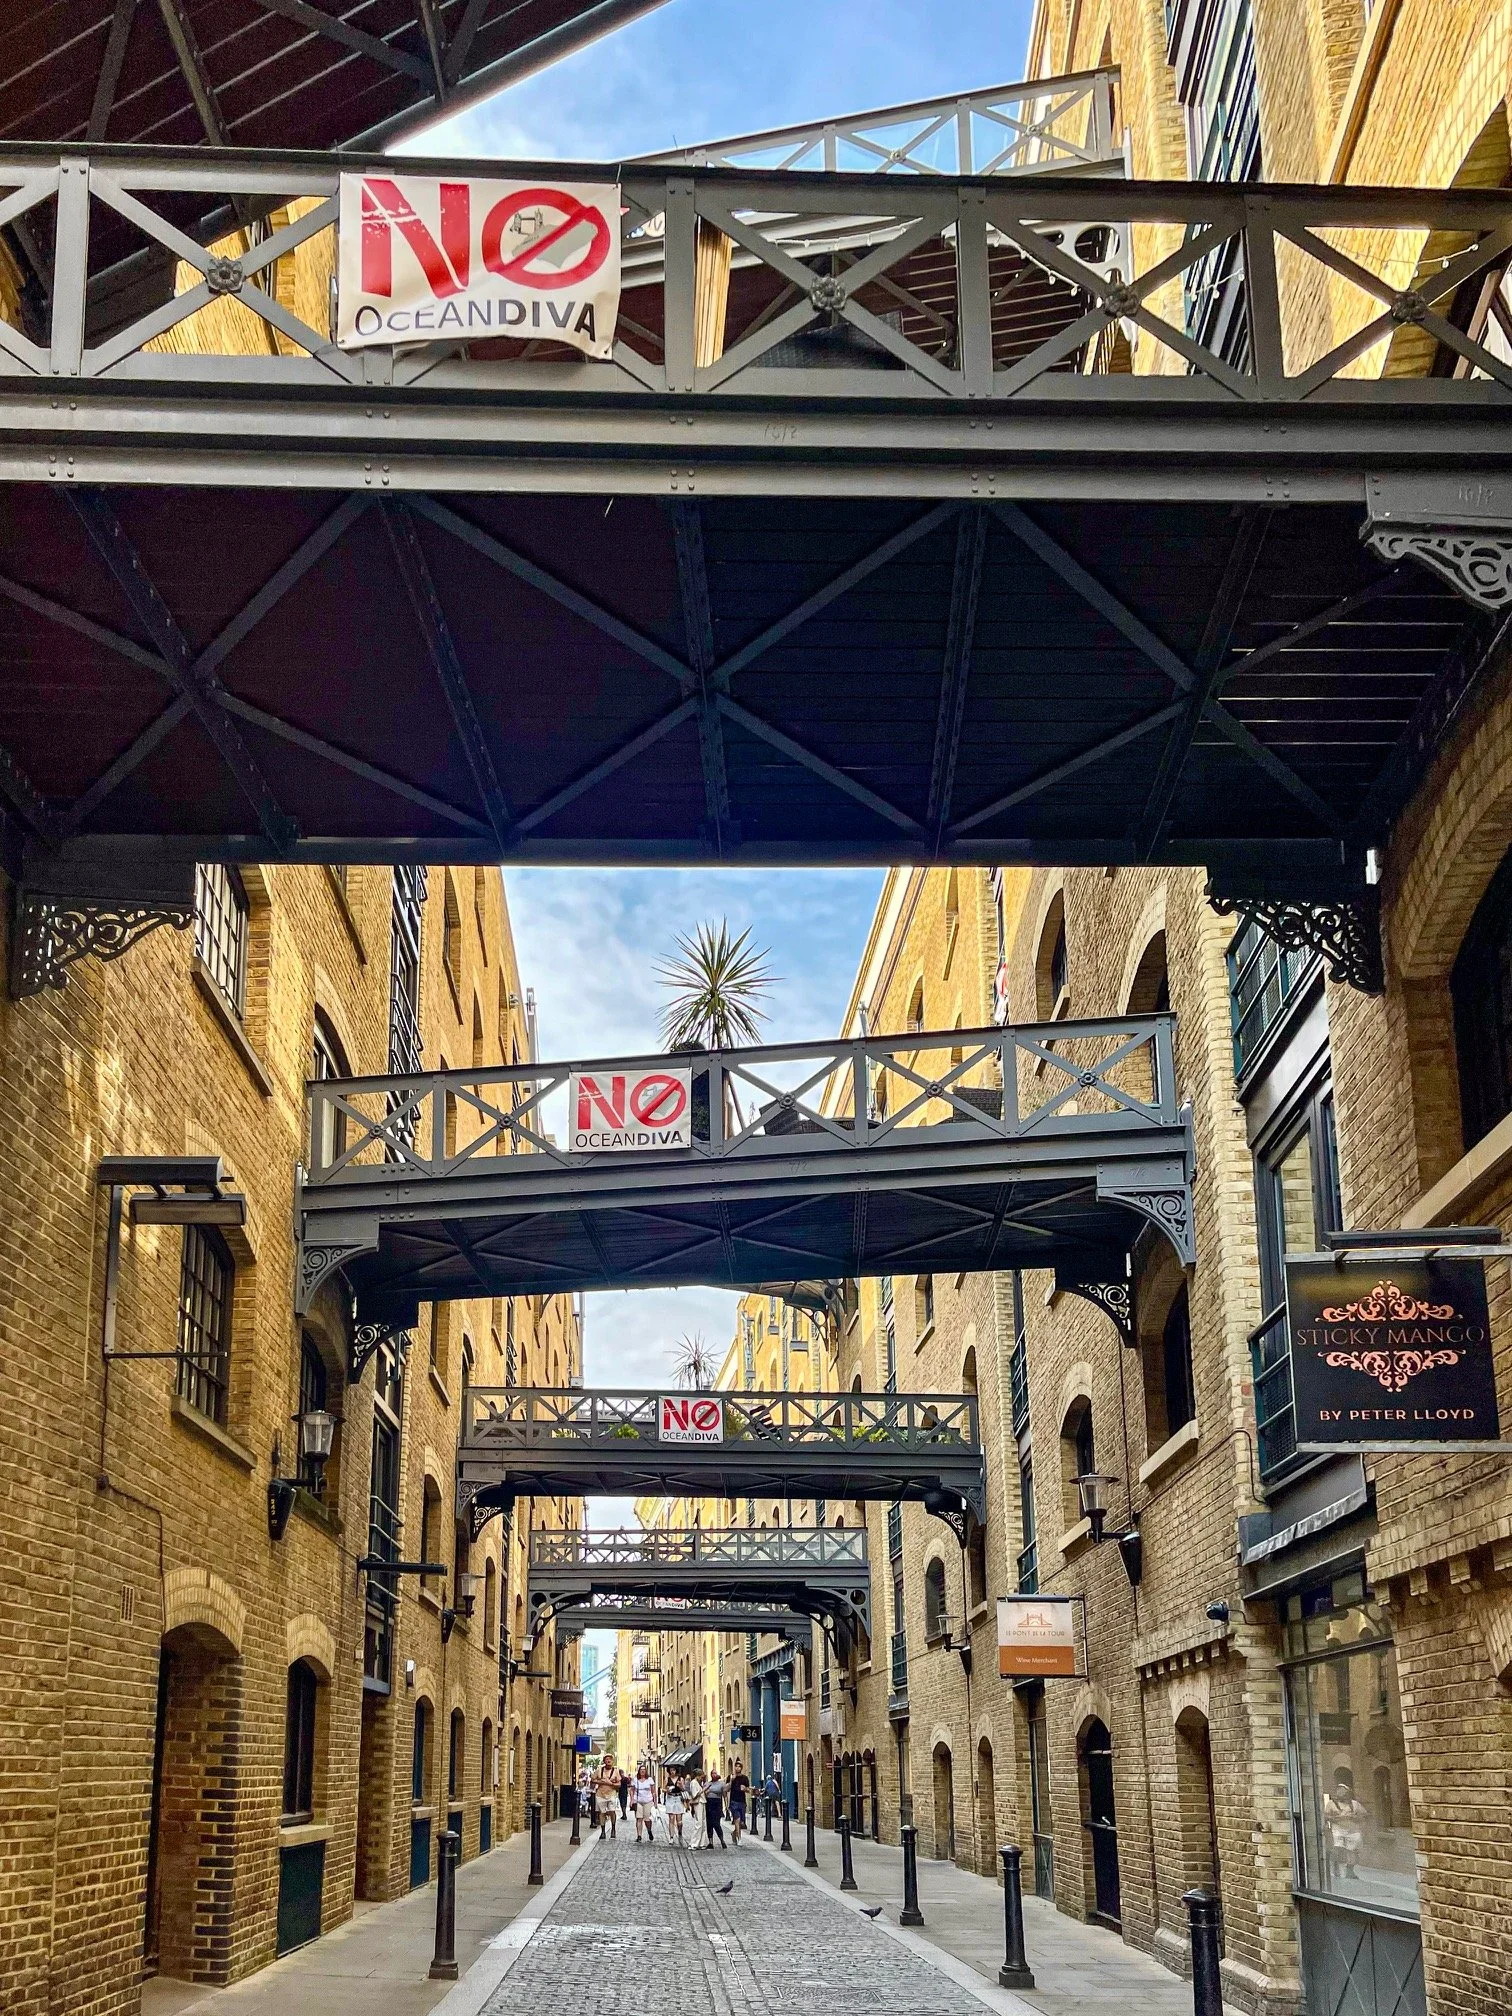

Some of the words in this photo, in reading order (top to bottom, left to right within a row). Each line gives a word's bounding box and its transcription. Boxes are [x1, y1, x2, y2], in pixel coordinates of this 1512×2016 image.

[361, 178, 611, 299] NO
[355, 299, 597, 343] OCEANDIVA
[577, 1074, 687, 1130] NO
[575, 1131, 683, 1148] OCEANDIVA
[1297, 1327, 1380, 1346] STICKY
[1388, 1325, 1485, 1345] MANGO
[663, 1399, 720, 1431] NO
[1319, 1410, 1342, 1421] BY
[1350, 1409, 1407, 1421] PETER
[1414, 1408, 1475, 1420] LLOYD
[662, 1431, 720, 1441] OCEANDIVA
[746, 1728, 757, 1738] 36
